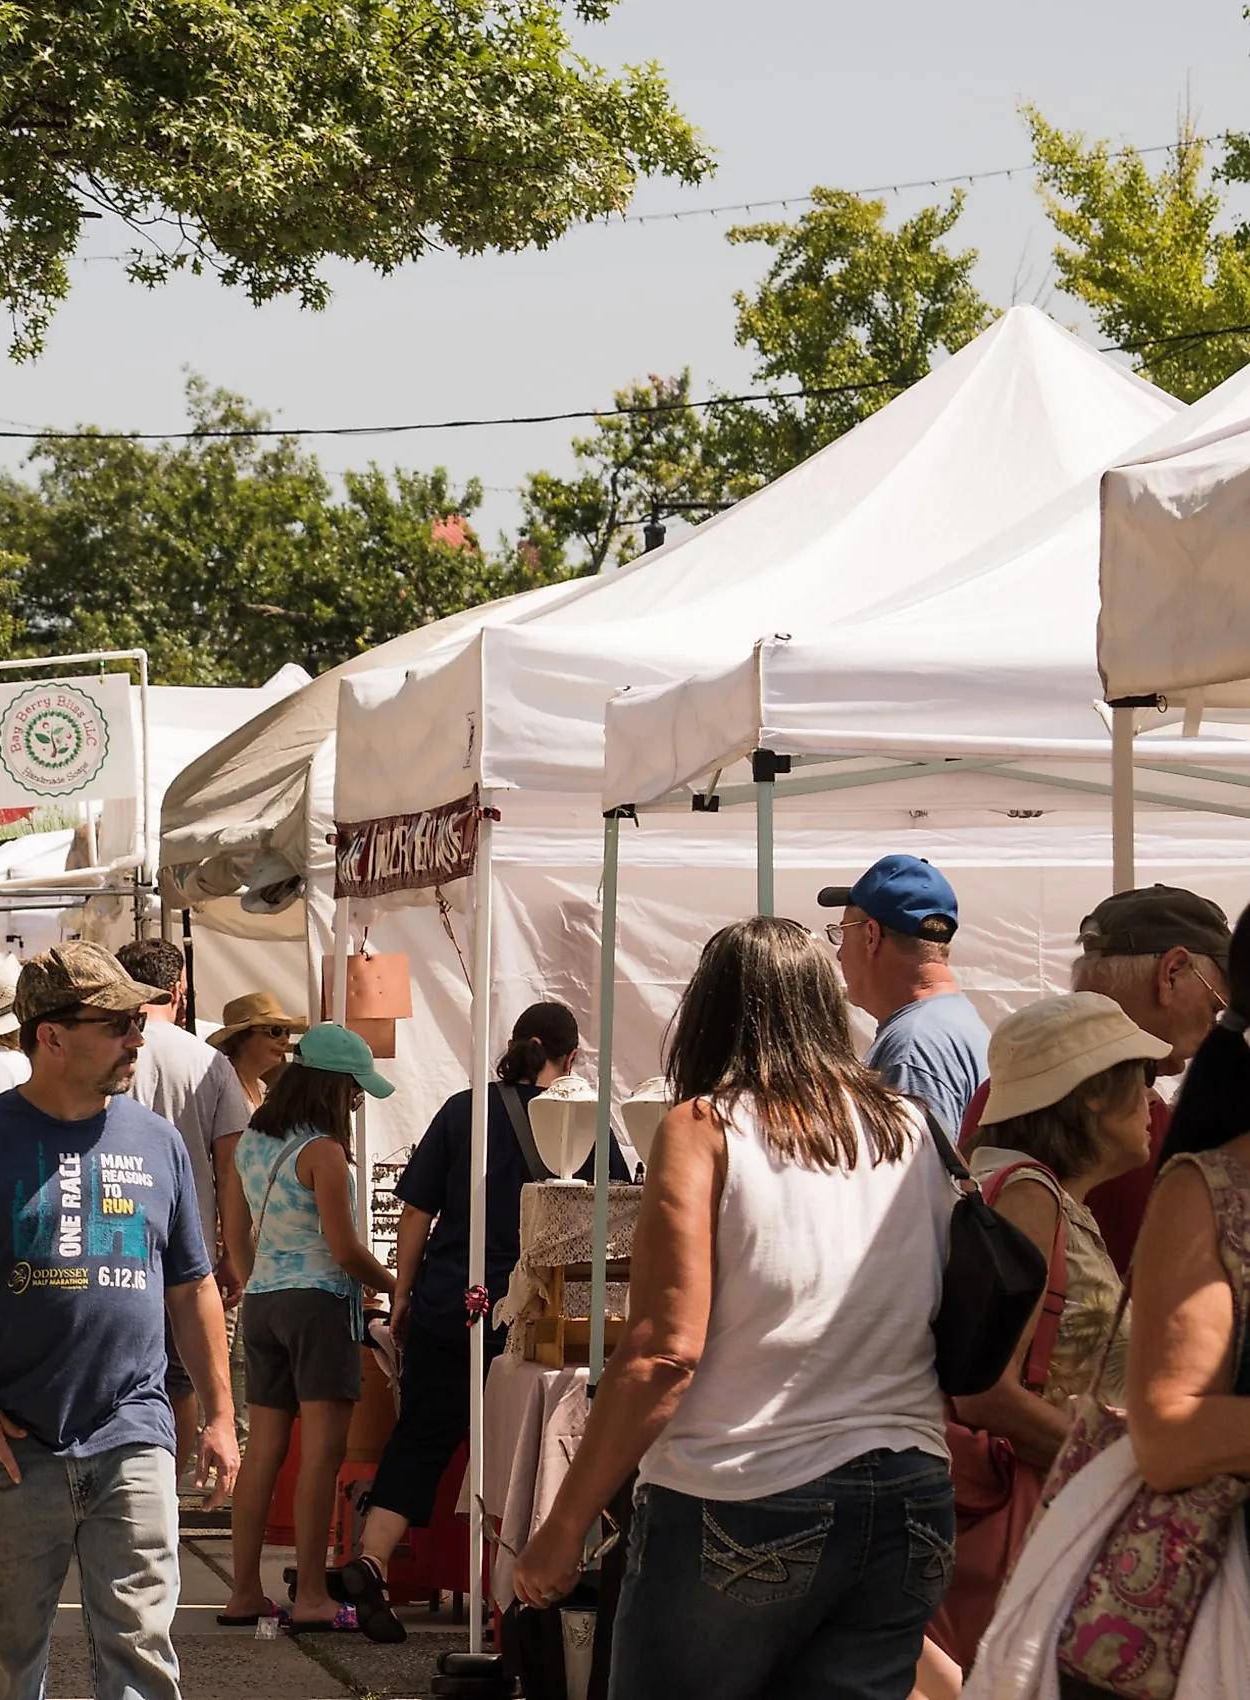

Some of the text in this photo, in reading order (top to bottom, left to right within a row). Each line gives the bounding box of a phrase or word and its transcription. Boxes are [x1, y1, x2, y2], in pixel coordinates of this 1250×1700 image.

[10, 695, 97, 753] Bay Berry Bliss LLC
[22, 762, 89, 785] Handmade Soaps
[100, 1153, 144, 1172] MANY
[58, 1152, 82, 1209] RACE
[101, 1169, 154, 1188] REASONS
[103, 1183, 123, 1199] TO
[103, 1197, 135, 1216] RUN
[58, 1213, 82, 1258] ONE
[32, 1267, 89, 1279] ODDYSSEY
[49, 1278, 89, 1287] MARATHON
[98, 1265, 147, 1291] 6.12.16
